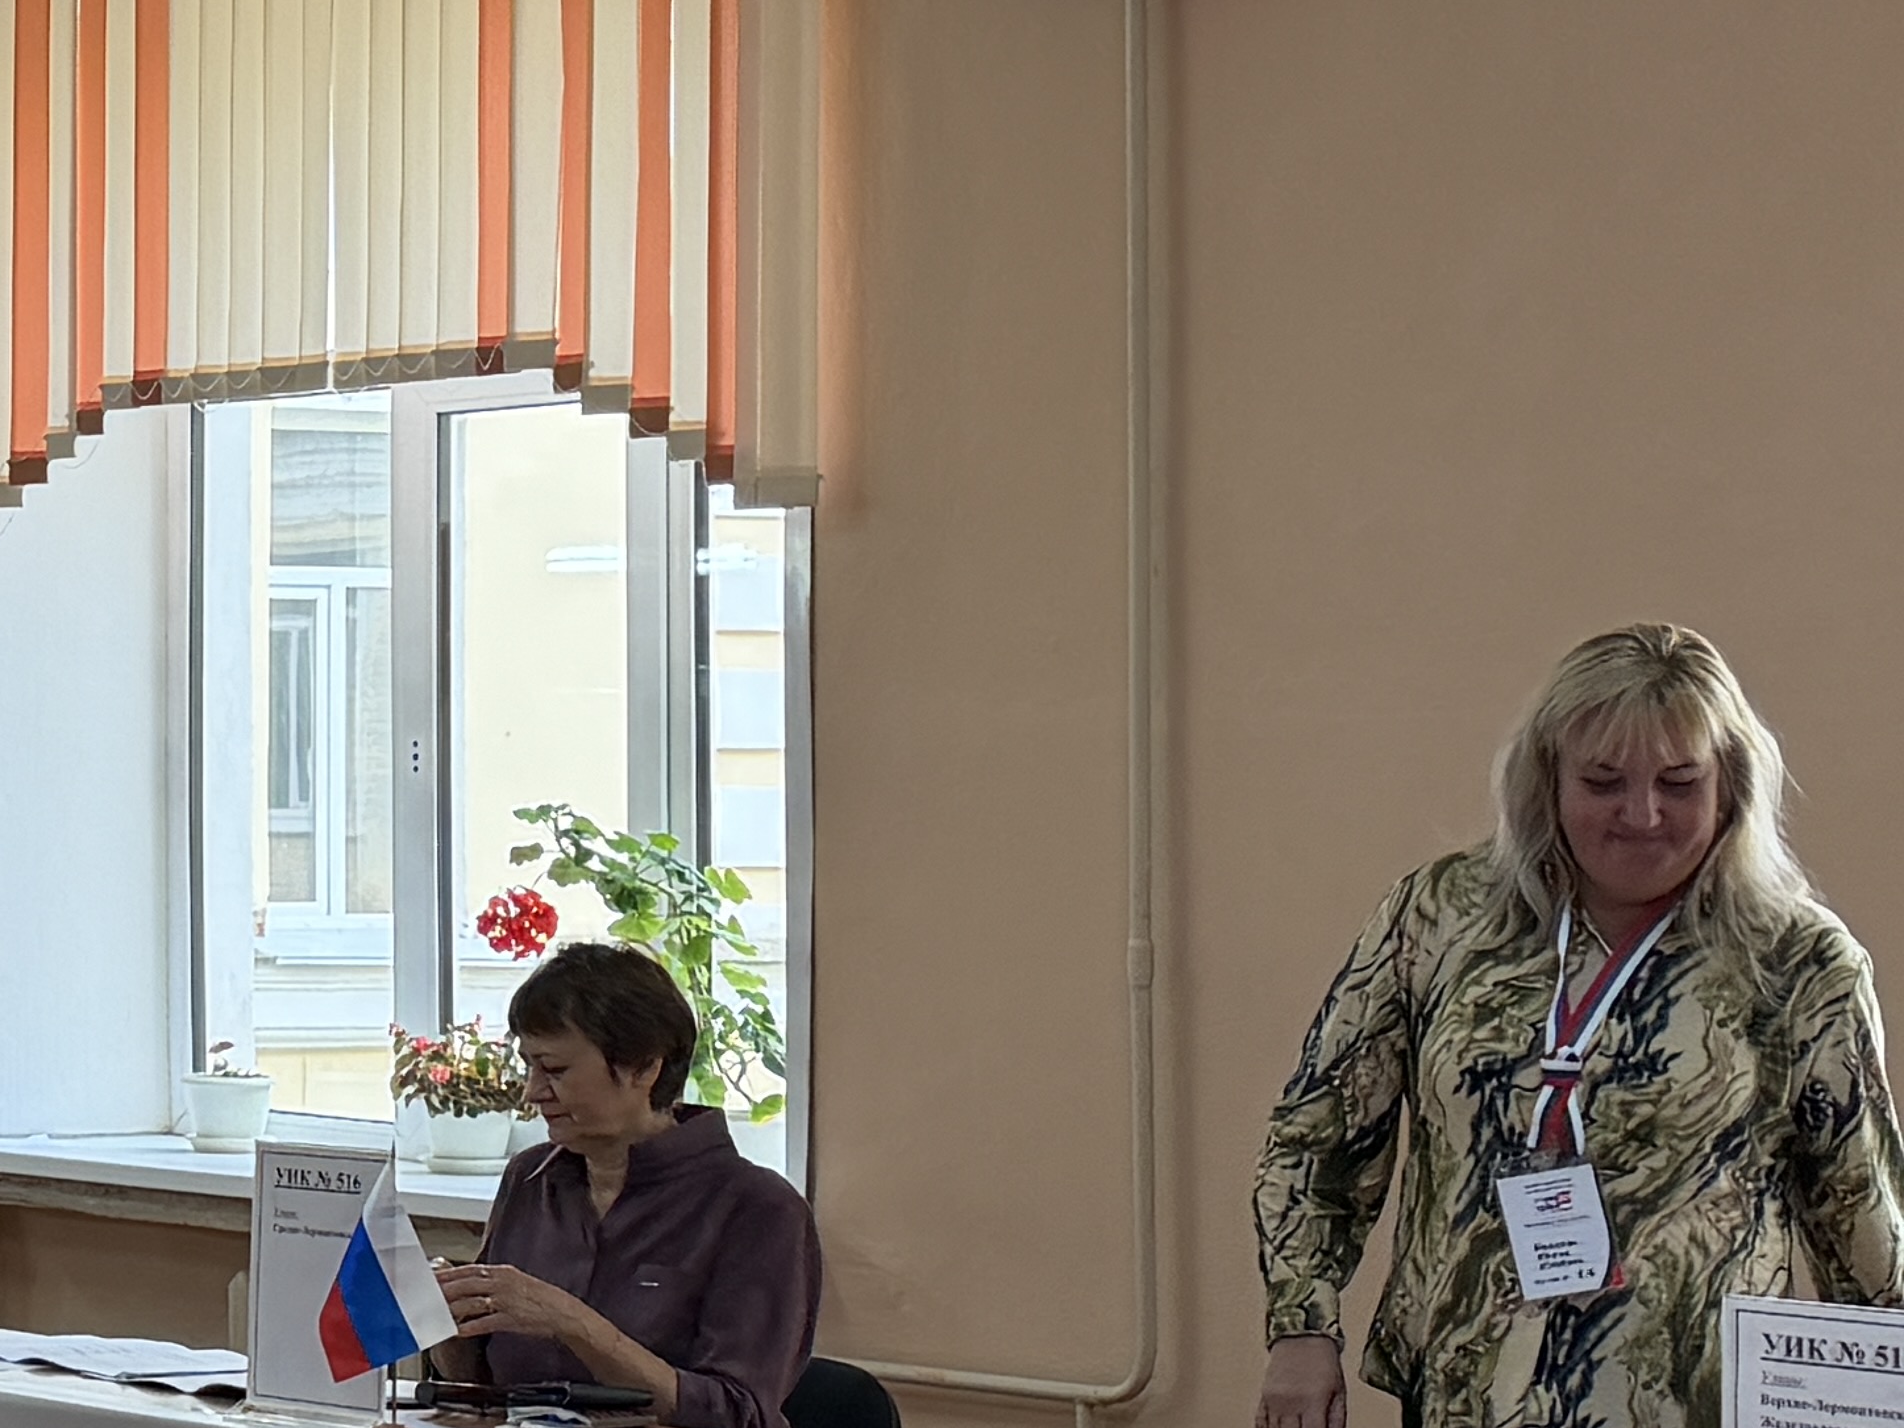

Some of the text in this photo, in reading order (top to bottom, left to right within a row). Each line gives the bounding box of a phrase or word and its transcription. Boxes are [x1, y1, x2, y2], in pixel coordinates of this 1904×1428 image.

[276, 1167, 361, 1190] УИК № 516
[1761, 1332, 1904, 1369] УИК № 51
[1760, 1393, 1904, 1421] Верхне-Лермонтовск
